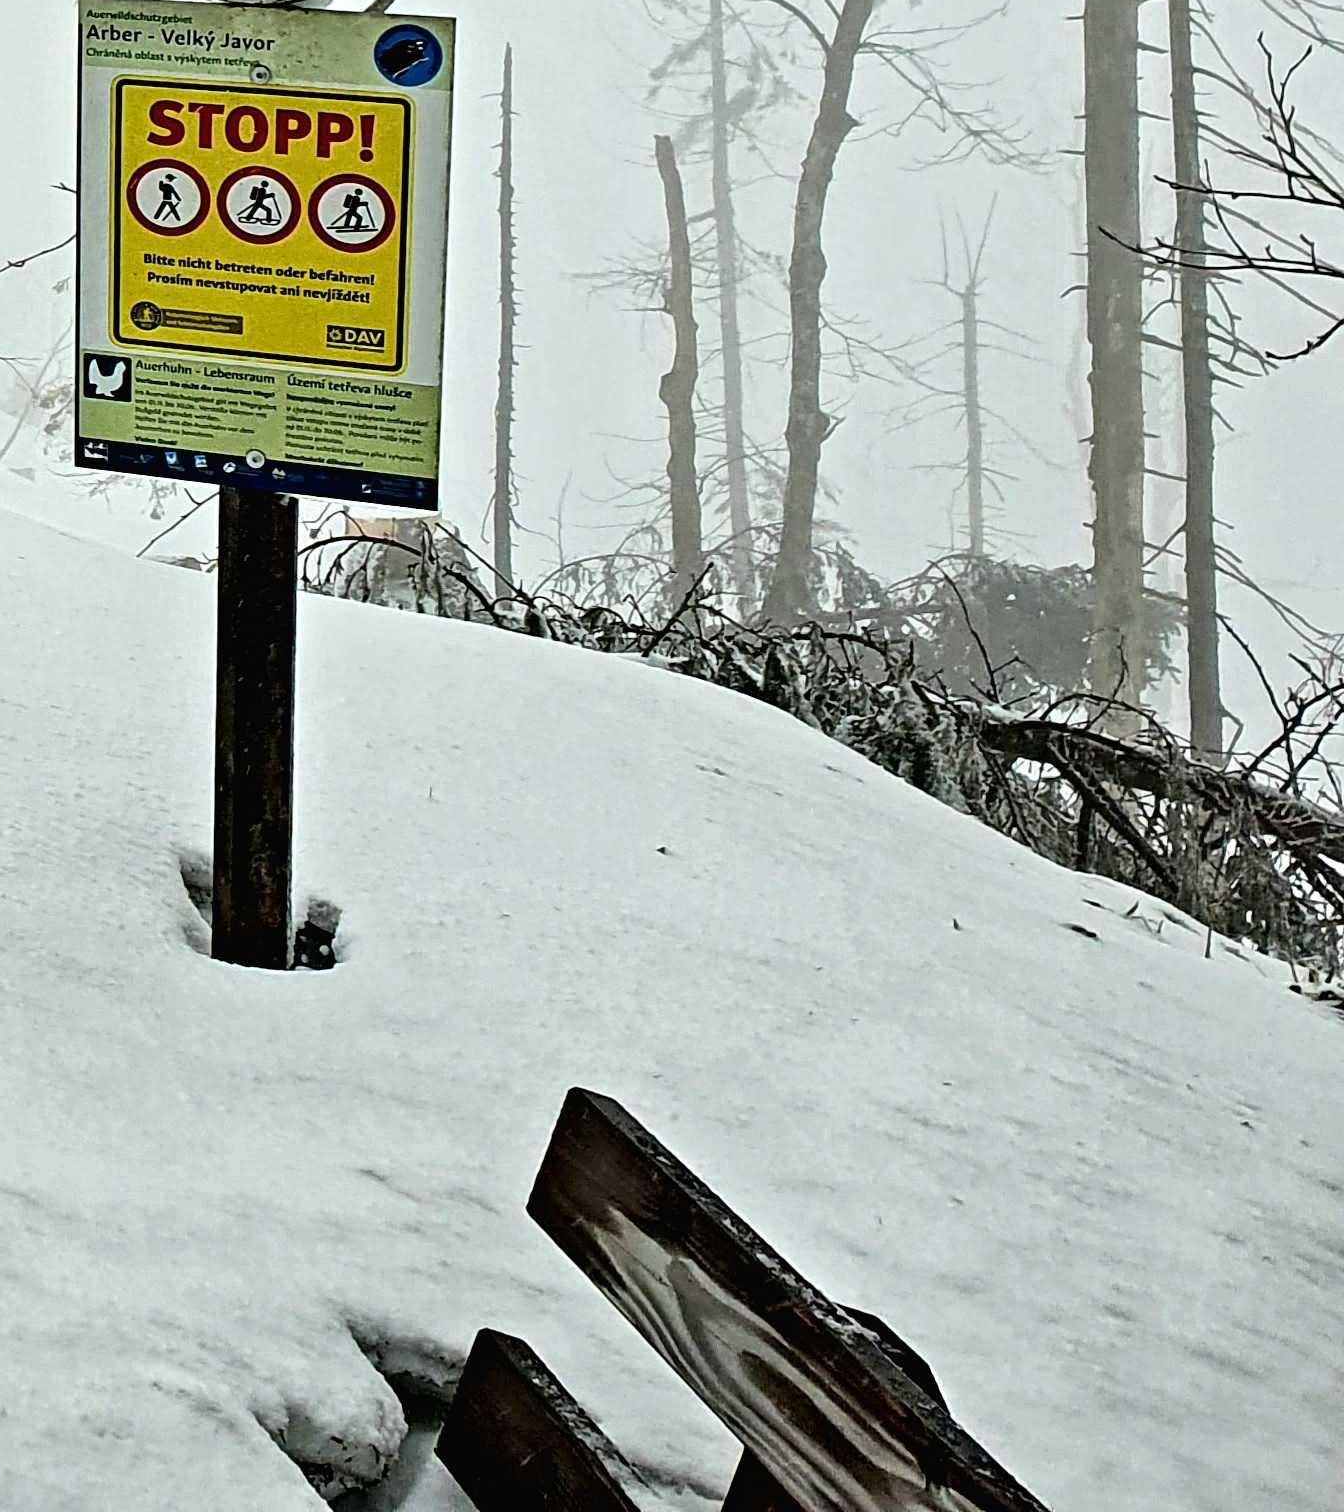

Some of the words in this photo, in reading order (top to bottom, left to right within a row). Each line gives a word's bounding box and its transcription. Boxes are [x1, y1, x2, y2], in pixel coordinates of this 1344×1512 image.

[86, 9, 193, 25] Auerwildschutzgebiet
[86, 24, 142, 43] Arber
[161, 29, 215, 51] Velký
[220, 33, 276, 50] Javor
[135, 50, 164, 61] oblast
[146, 99, 375, 163] STOPP!
[143, 253, 176, 266] Bitte
[178, 257, 211, 271] nicht
[215, 260, 272, 276] betreten
[275, 267, 307, 278] oder
[309, 269, 375, 285] befahren!
[147, 271, 193, 286] Prosím
[195, 278, 277, 295] nevstupovat
[279, 284, 300, 296] ani
[303, 288, 370, 303] nevjíždět!
[344, 329, 383, 345] DAV
[135, 359, 192, 375] Auerhuhn
[203, 366, 275, 384] Lebensraum
[287, 373, 325, 389] Území
[328, 380, 371, 395] tetřeva
[374, 385, 413, 399] hlušce
